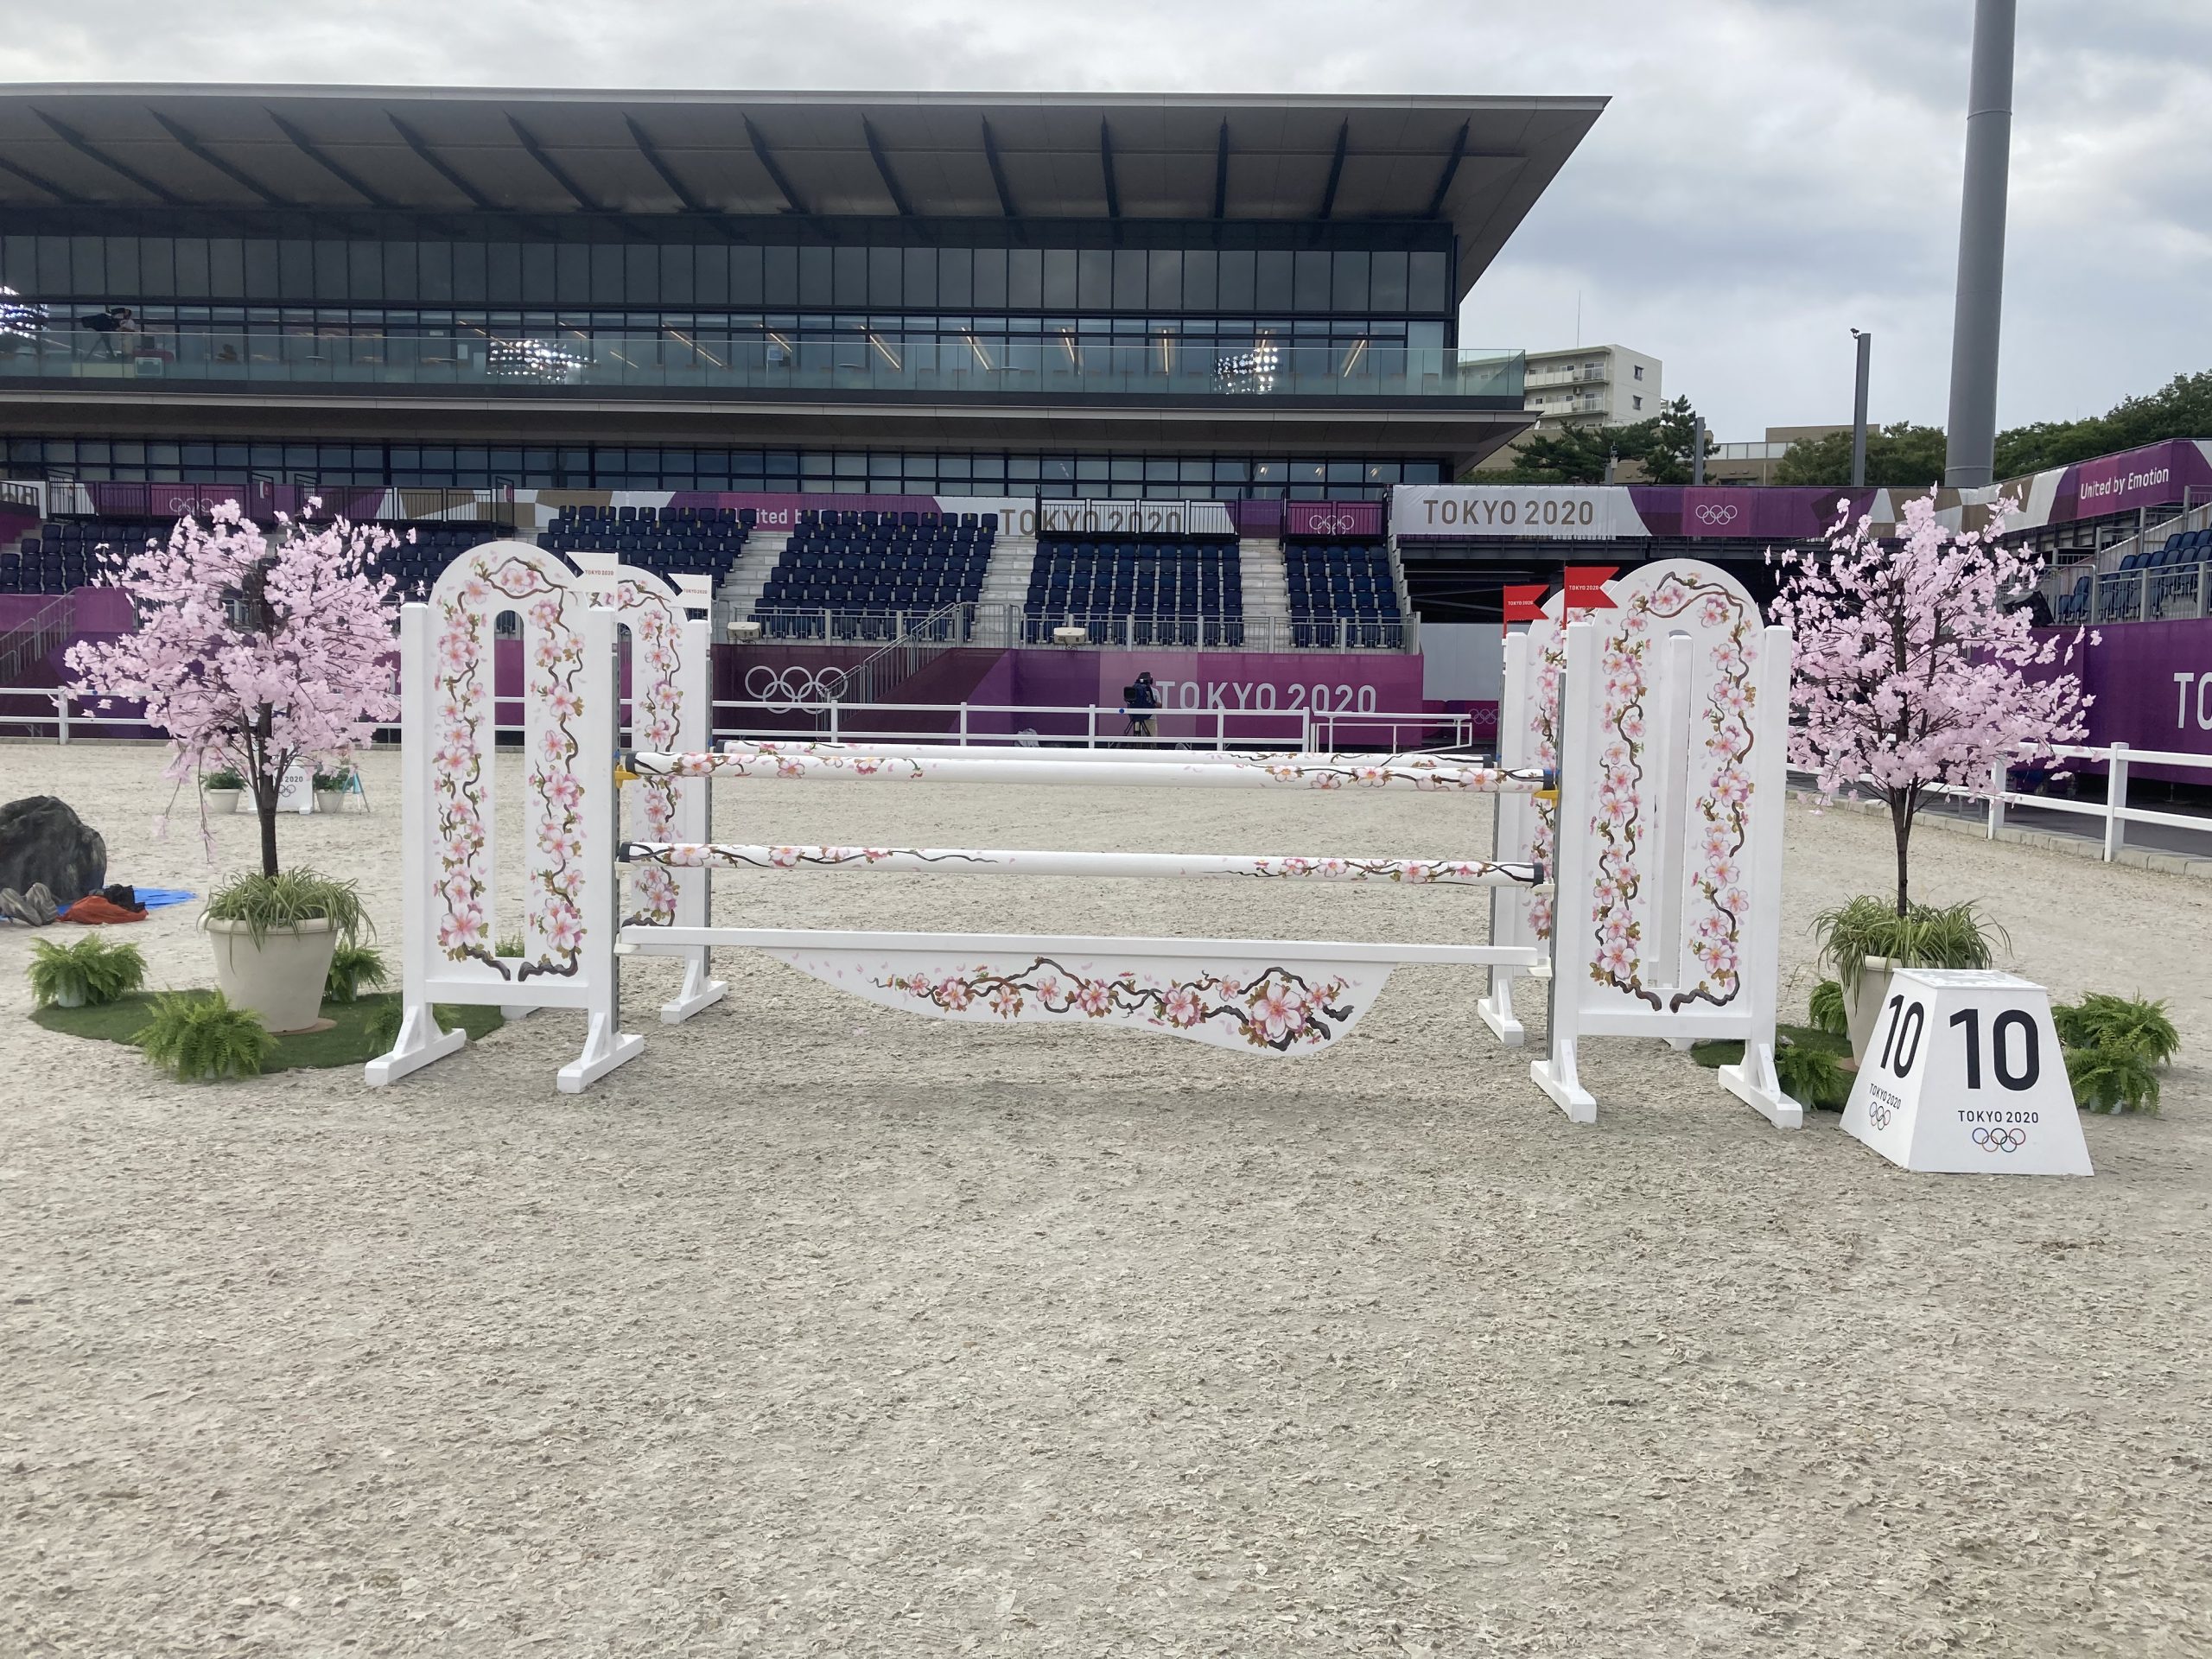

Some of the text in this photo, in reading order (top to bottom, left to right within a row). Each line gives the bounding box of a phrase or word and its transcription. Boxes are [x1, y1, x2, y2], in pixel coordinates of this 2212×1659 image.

[2080, 467, 2169, 499] United by Emotion
[1000, 509, 1181, 535] TOKYO 2020
[1423, 499, 1593, 524] TOKYO 2020
[1155, 681, 1376, 713] TOKYO 2020
[1880, 994, 1924, 1078] 10
[1949, 1008, 2039, 1091] 10
[1869, 1083, 1902, 1109] TOKYO 2020
[1957, 1110, 2039, 1123] TOKYO 2020
